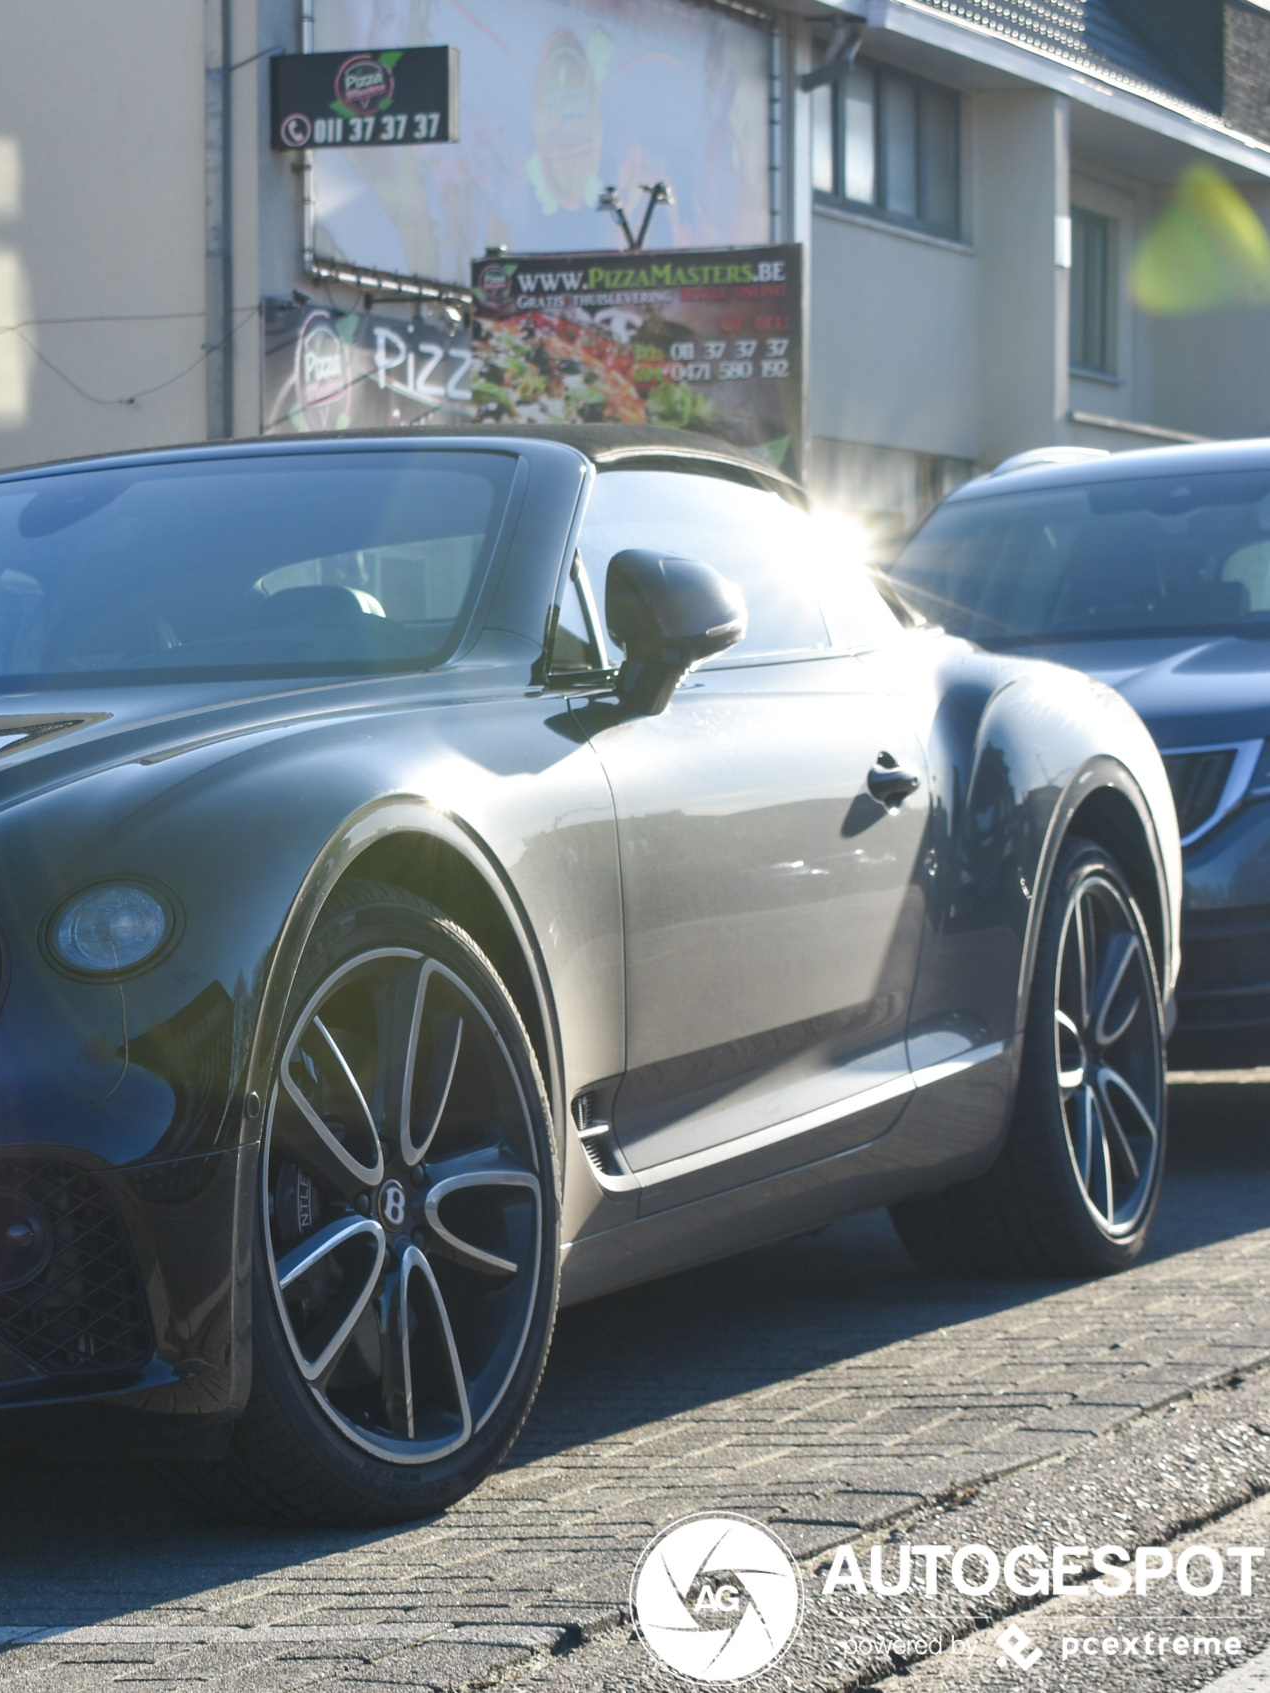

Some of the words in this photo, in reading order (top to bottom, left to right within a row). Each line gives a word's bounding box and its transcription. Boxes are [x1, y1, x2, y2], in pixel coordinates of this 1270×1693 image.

[344, 74, 382, 90] Pizza
[313, 118, 343, 144] 011
[348, 116, 375, 142] 37
[380, 114, 408, 140] 37
[413, 112, 441, 139] 37
[669, 341, 695, 361] 011
[704, 340, 727, 360] 37
[734, 340, 758, 359] 37
[765, 338, 790, 358] 37
[669, 361, 711, 382] 0471
[760, 358, 790, 379] 192
